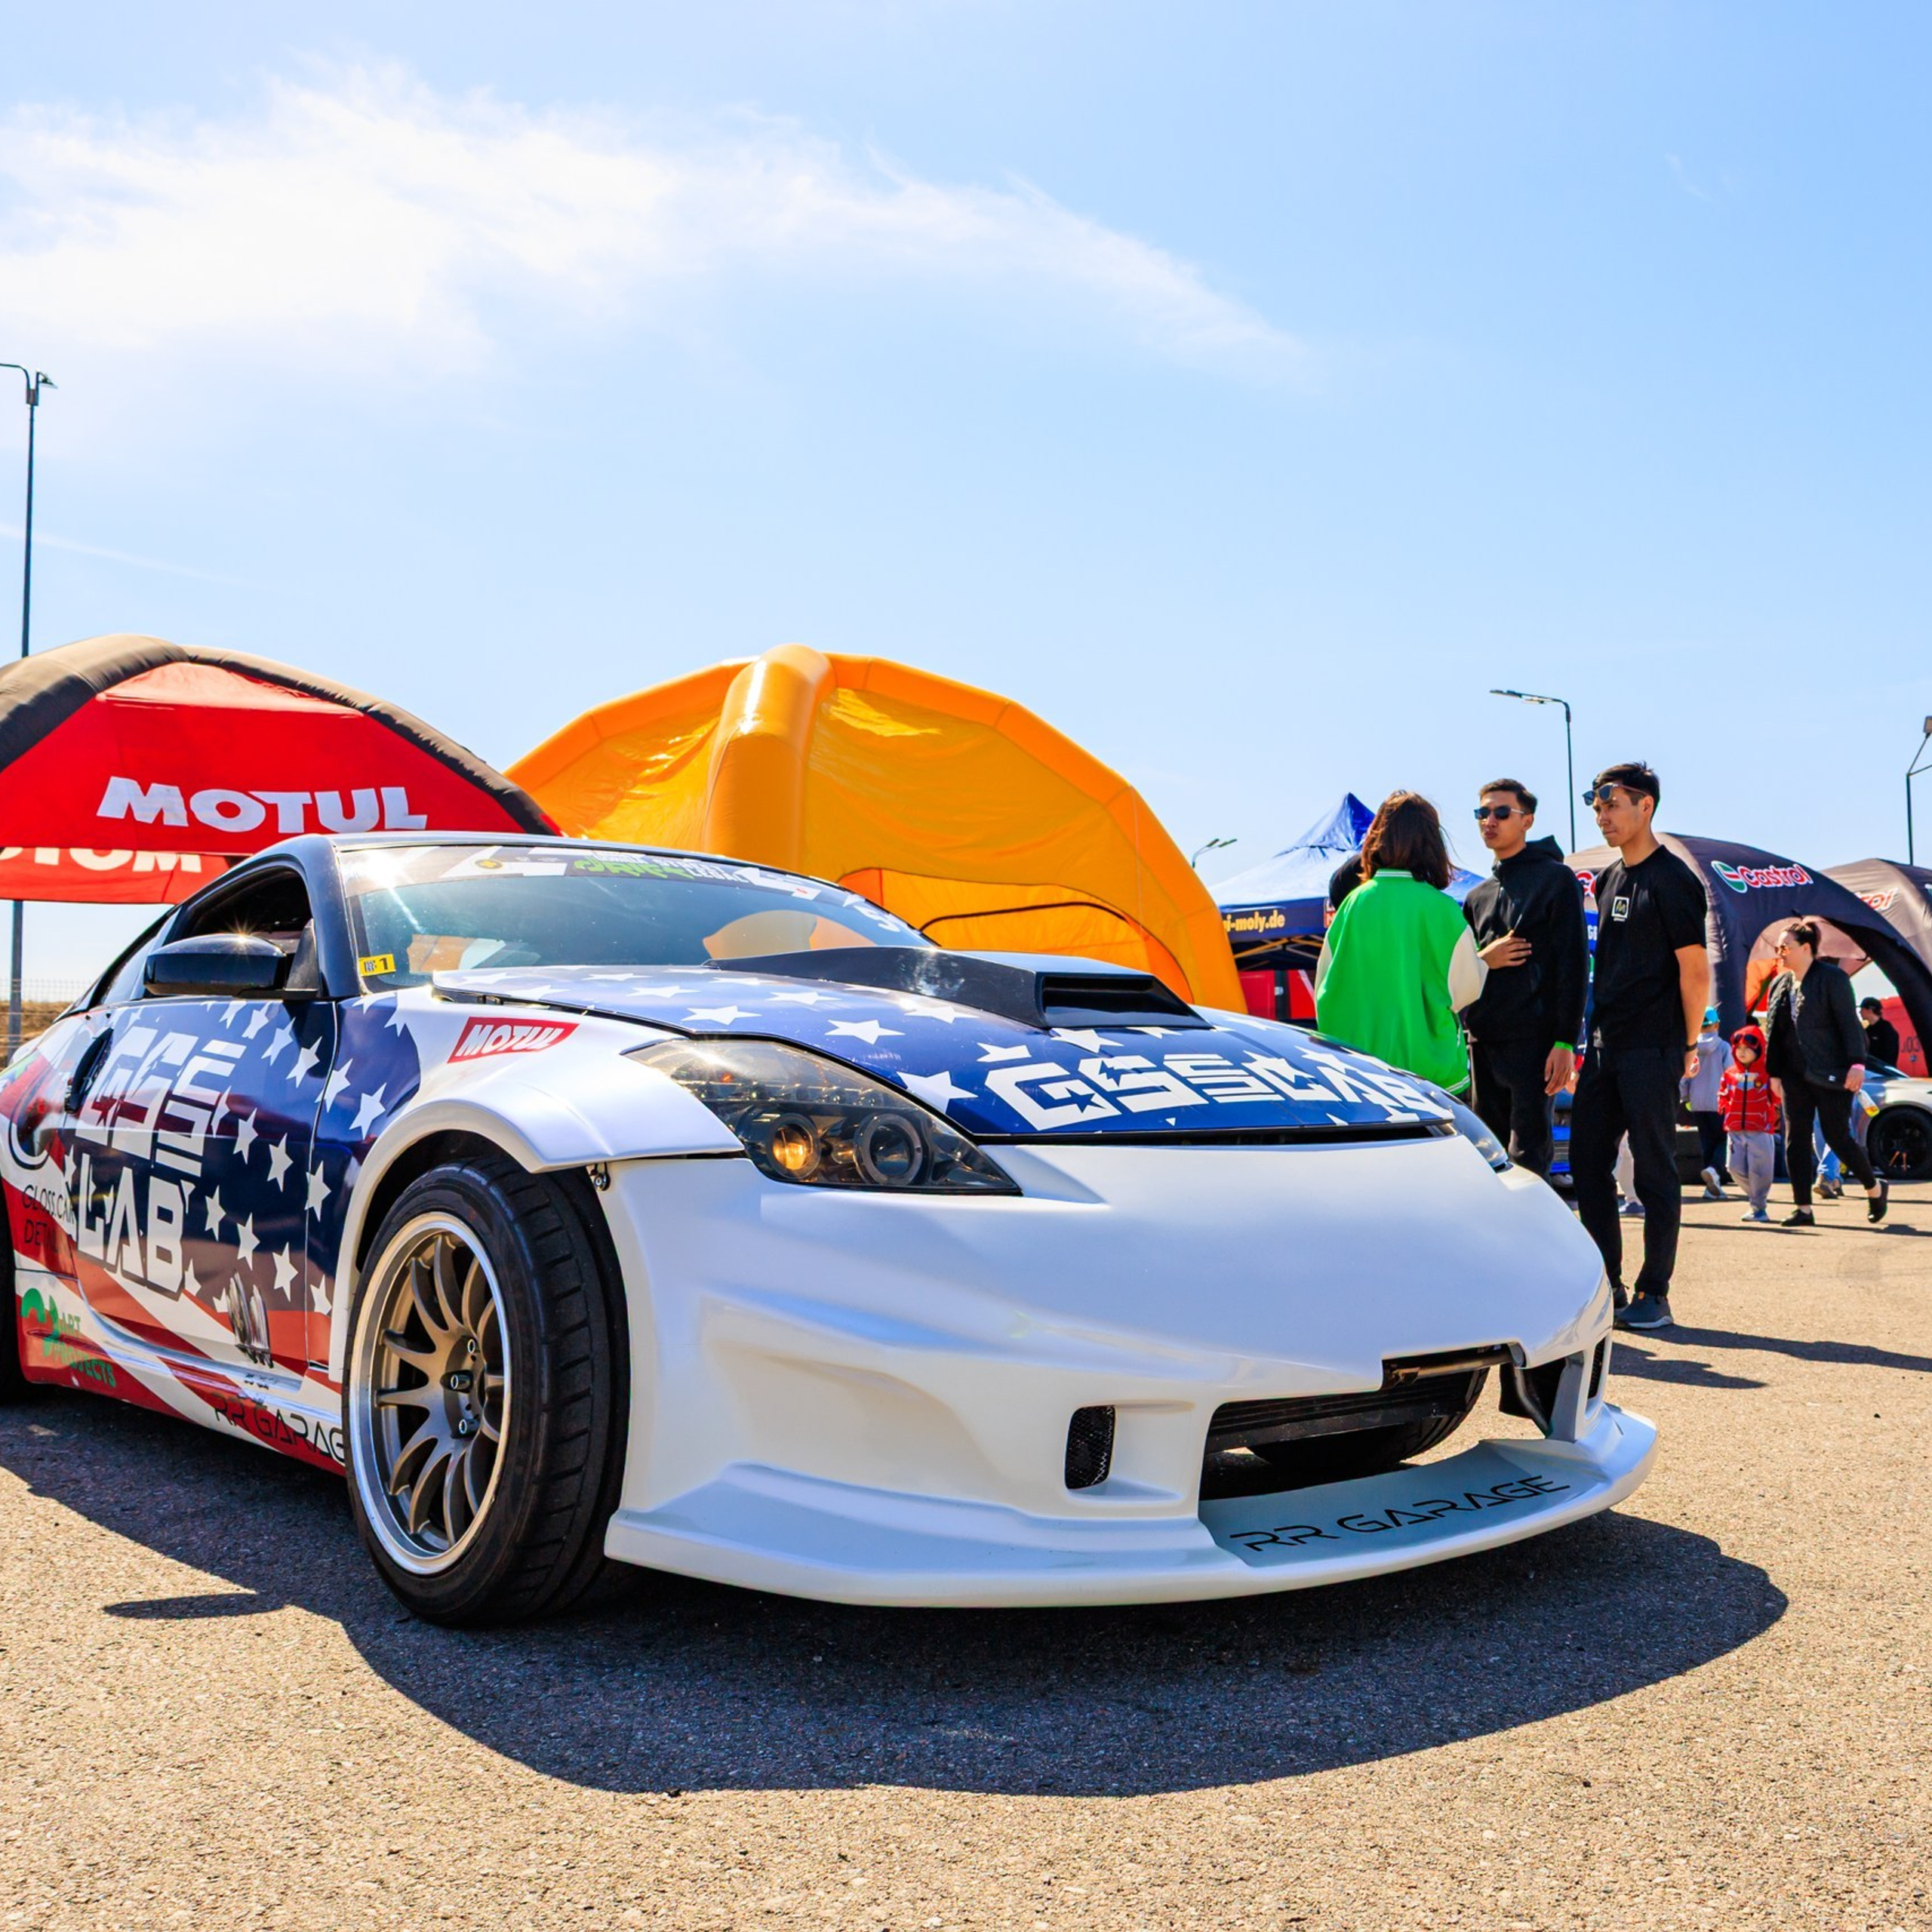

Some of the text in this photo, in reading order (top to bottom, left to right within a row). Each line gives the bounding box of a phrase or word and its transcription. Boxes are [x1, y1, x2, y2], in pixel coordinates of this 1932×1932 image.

[96, 776, 428, 833] MOTUL
[1737, 863, 1814, 888] Castrol
[454, 1024, 565, 1057] MOTUL
[78, 1153, 184, 1293] LAB
[253, 1404, 345, 1463] GARAG
[1229, 1475, 1571, 1552] RR GARAGE
